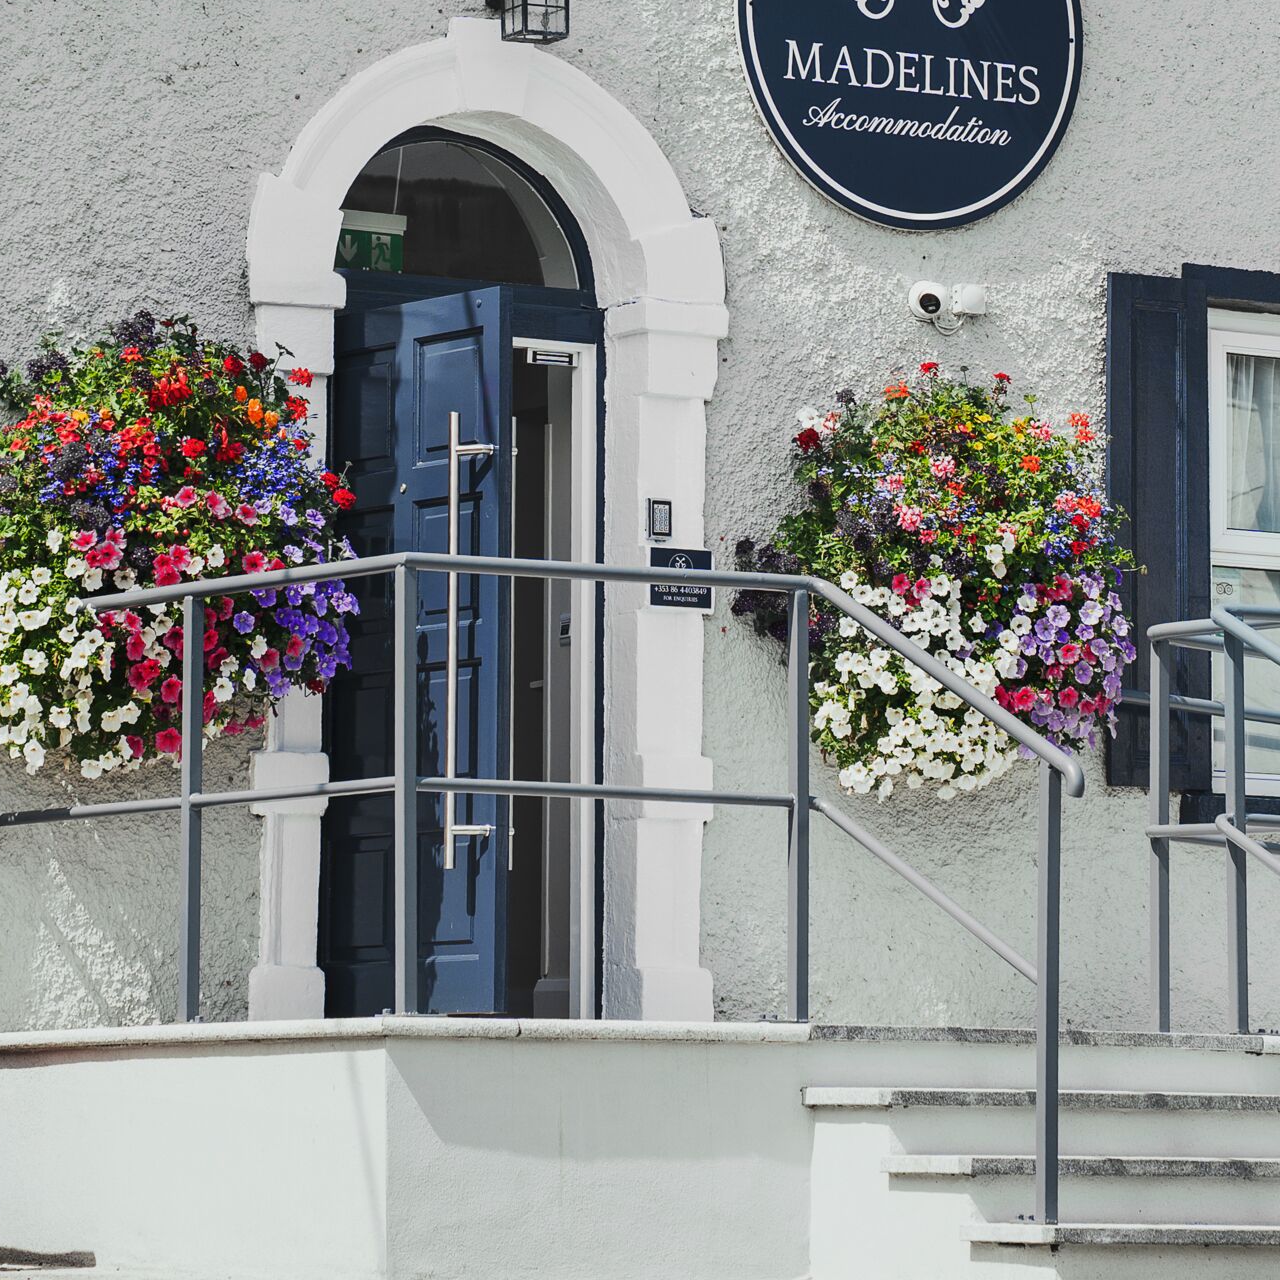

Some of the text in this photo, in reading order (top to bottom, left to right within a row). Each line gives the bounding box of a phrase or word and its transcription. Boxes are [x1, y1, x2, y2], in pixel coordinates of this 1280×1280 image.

[783, 39, 1041, 106] MADELINES
[803, 97, 1012, 146] Accommodation
[654, 585, 669, 593] +353
